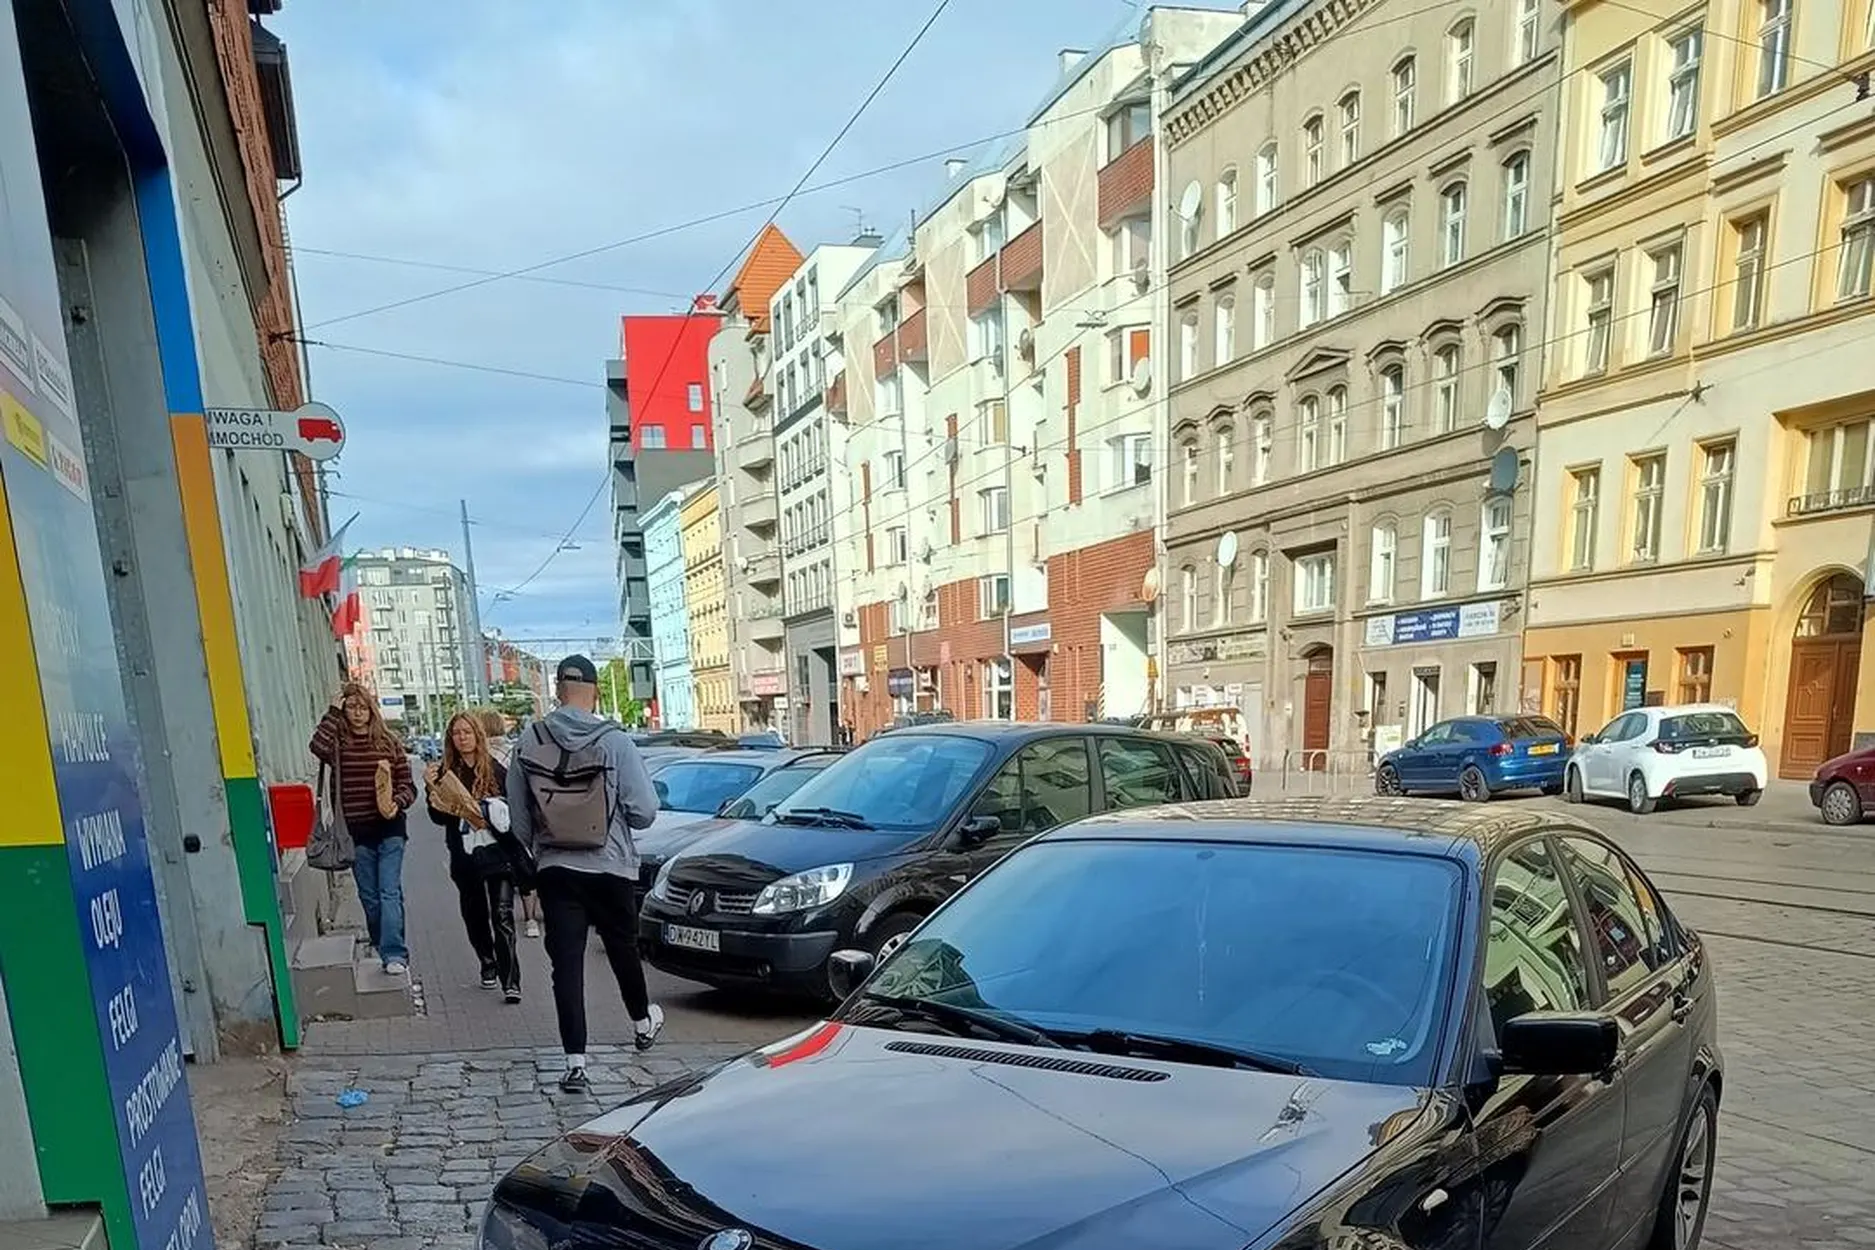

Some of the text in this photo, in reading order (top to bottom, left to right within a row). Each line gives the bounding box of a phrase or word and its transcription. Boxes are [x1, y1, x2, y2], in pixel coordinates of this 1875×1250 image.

[58, 711, 110, 763] HAMULCE
[75, 808, 126, 871] WYMIANA
[91, 888, 122, 949] OLEJU
[108, 984, 138, 1051] FELGI
[126, 1037, 181, 1149] PROSTOWANIE
[139, 1144, 167, 1221] FELGI
